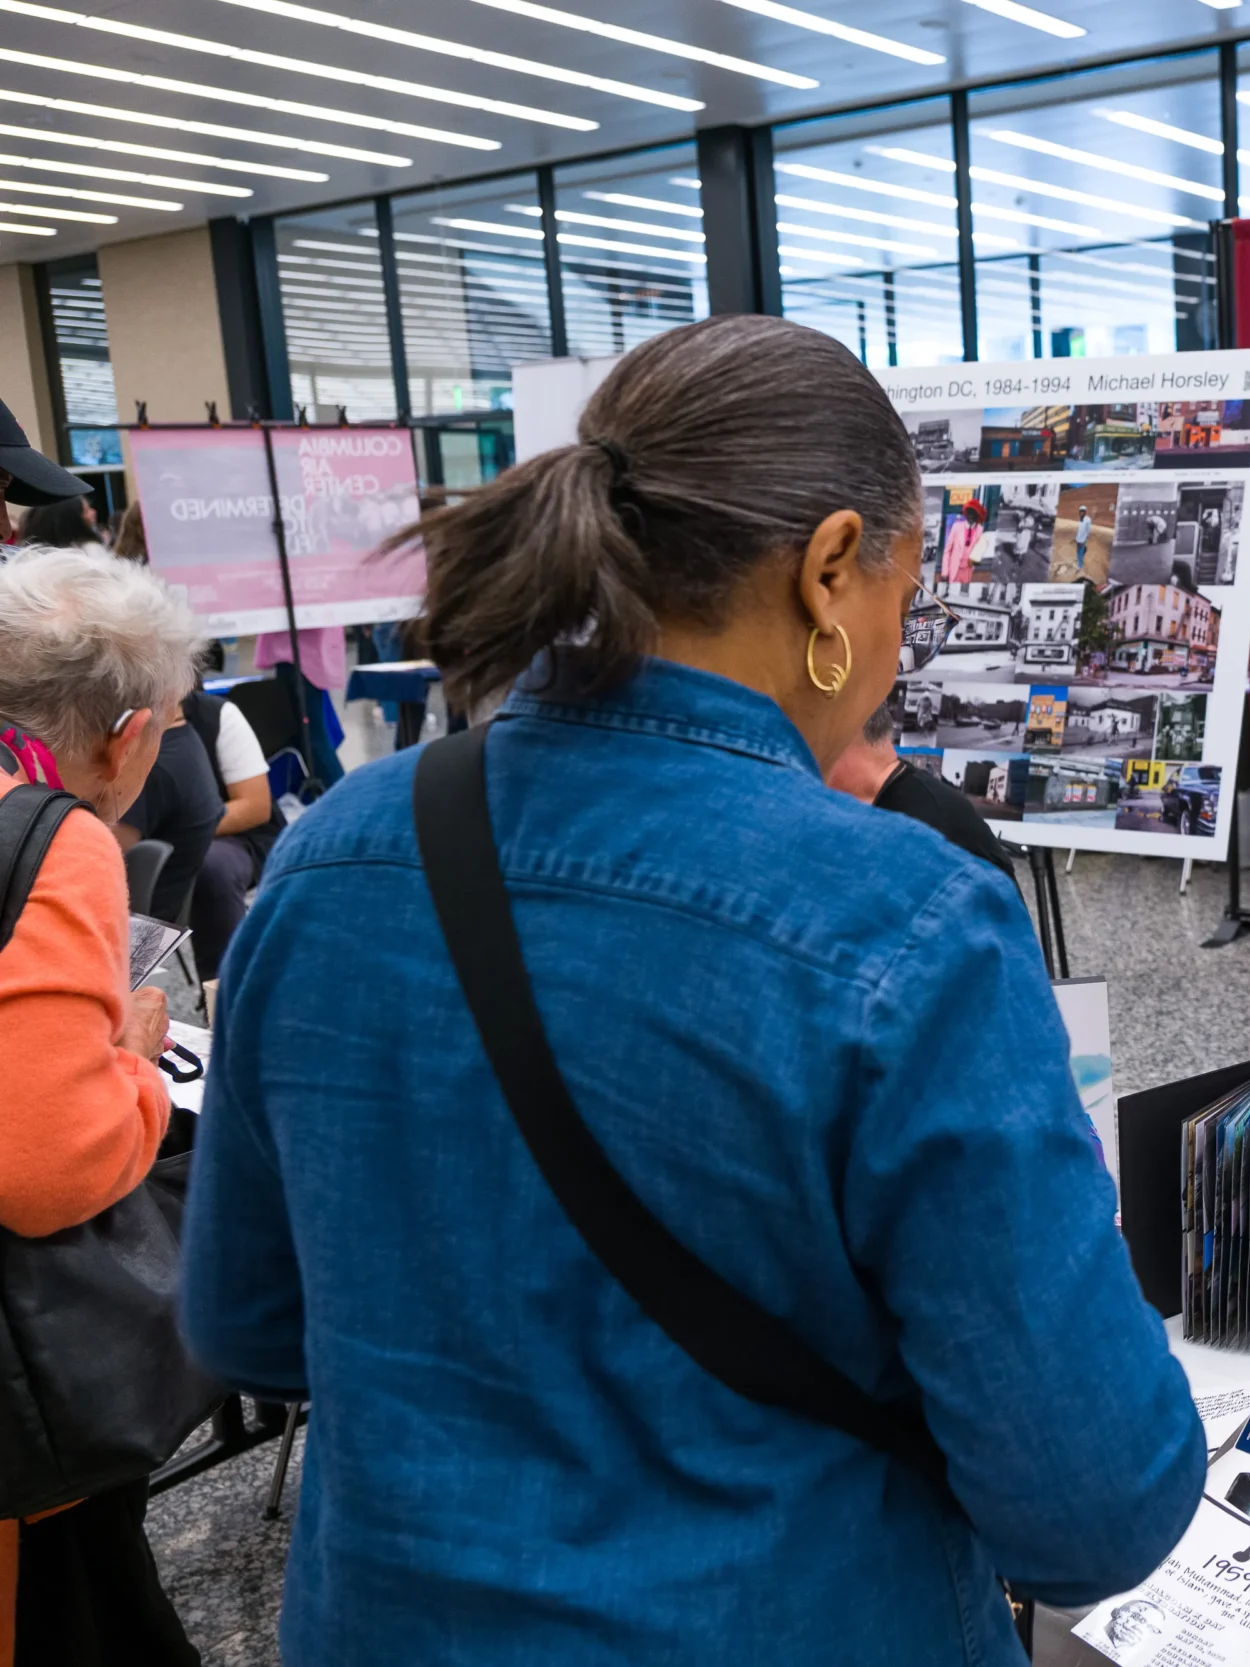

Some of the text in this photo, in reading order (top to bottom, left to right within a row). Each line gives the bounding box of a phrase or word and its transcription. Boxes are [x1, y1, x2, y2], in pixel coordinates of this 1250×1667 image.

[884, 371, 1230, 404] hington DC, 1984-1994 Michael Horsley
[1165, 1568, 1176, 1577] of
[1177, 1575, 1208, 1598] Islam,
[1208, 1594, 1232, 1610] gave
[1184, 1567, 1242, 1604] Muhammad,
